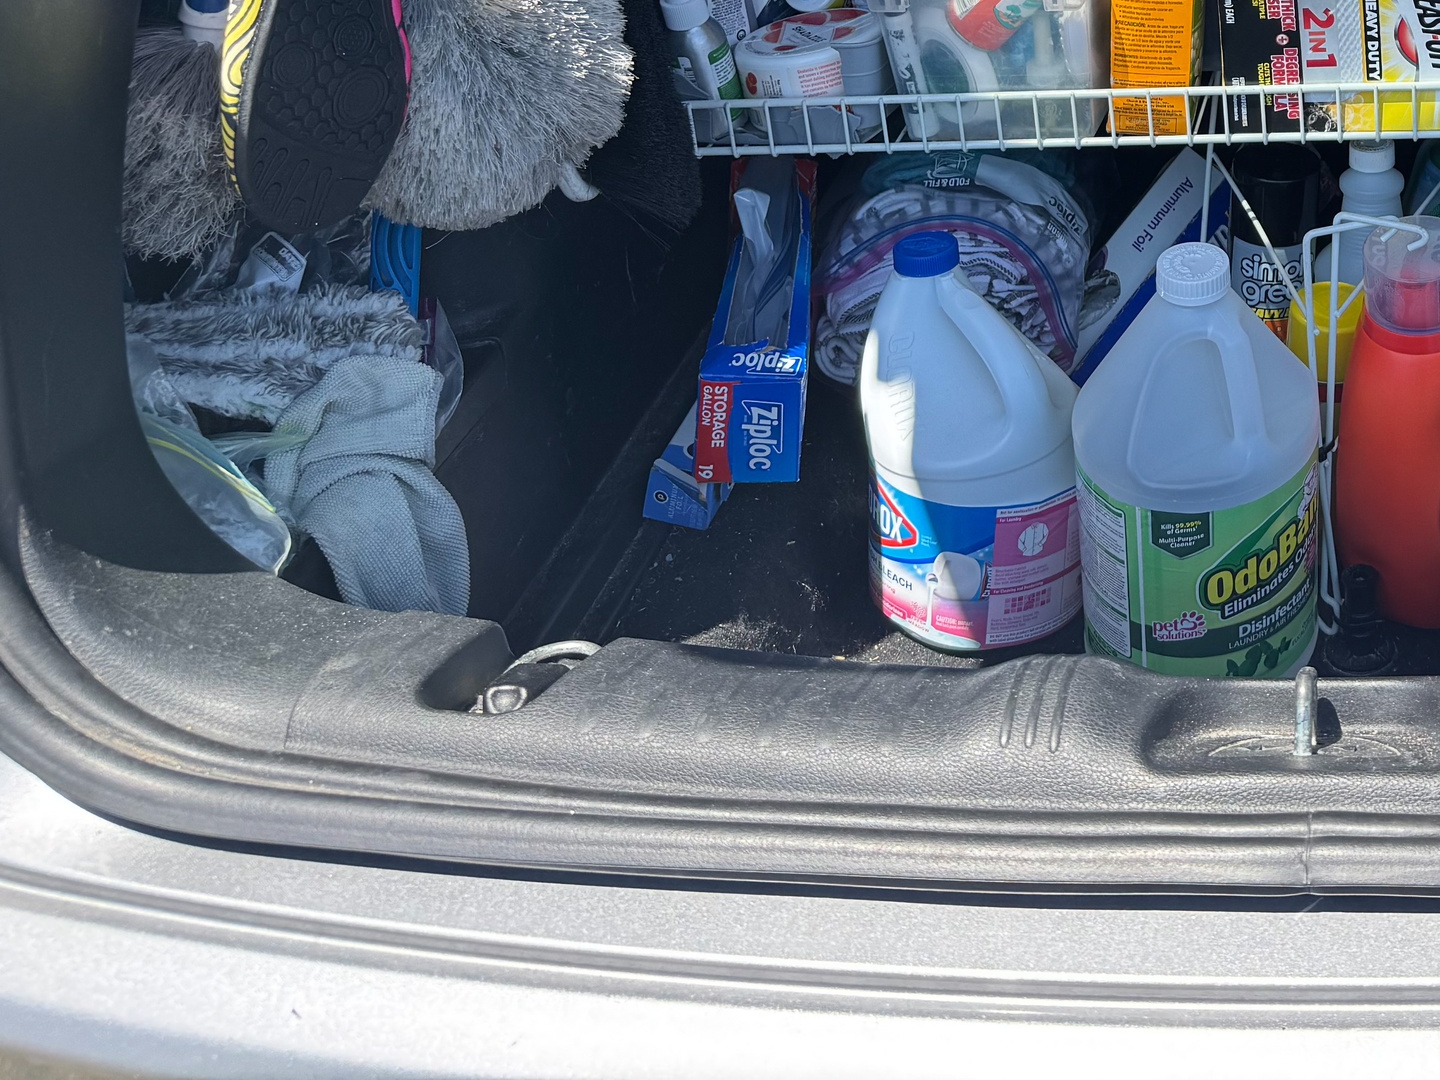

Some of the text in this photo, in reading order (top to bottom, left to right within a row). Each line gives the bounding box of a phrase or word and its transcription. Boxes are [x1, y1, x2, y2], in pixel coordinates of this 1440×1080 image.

[1225, 9, 1235, 24] EACH
[1366, 41, 1382, 80] DUTY
[923, 177, 971, 188] FOLD & FILL
[1131, 176, 1194, 253] Aluminum Foil
[731, 351, 797, 374] Ziploc
[701, 385, 713, 426] GALLON
[711, 385, 729, 448] STORAGE
[741, 406, 779, 471] Ziploc
[698, 464, 714, 479] 19
[1159, 533, 1204, 544] Multi-Purpose
[1175, 521, 1202, 529] 99.99%
[877, 561, 913, 591] BLEACH
[1224, 562, 1294, 617] Eliminates
[1238, 579, 1311, 638] Disinfectant
[1152, 619, 1179, 635] pet
[1158, 629, 1202, 641] solutions
[1229, 628, 1269, 649] LAUNDRY
[1275, 617, 1286, 630] AIR
